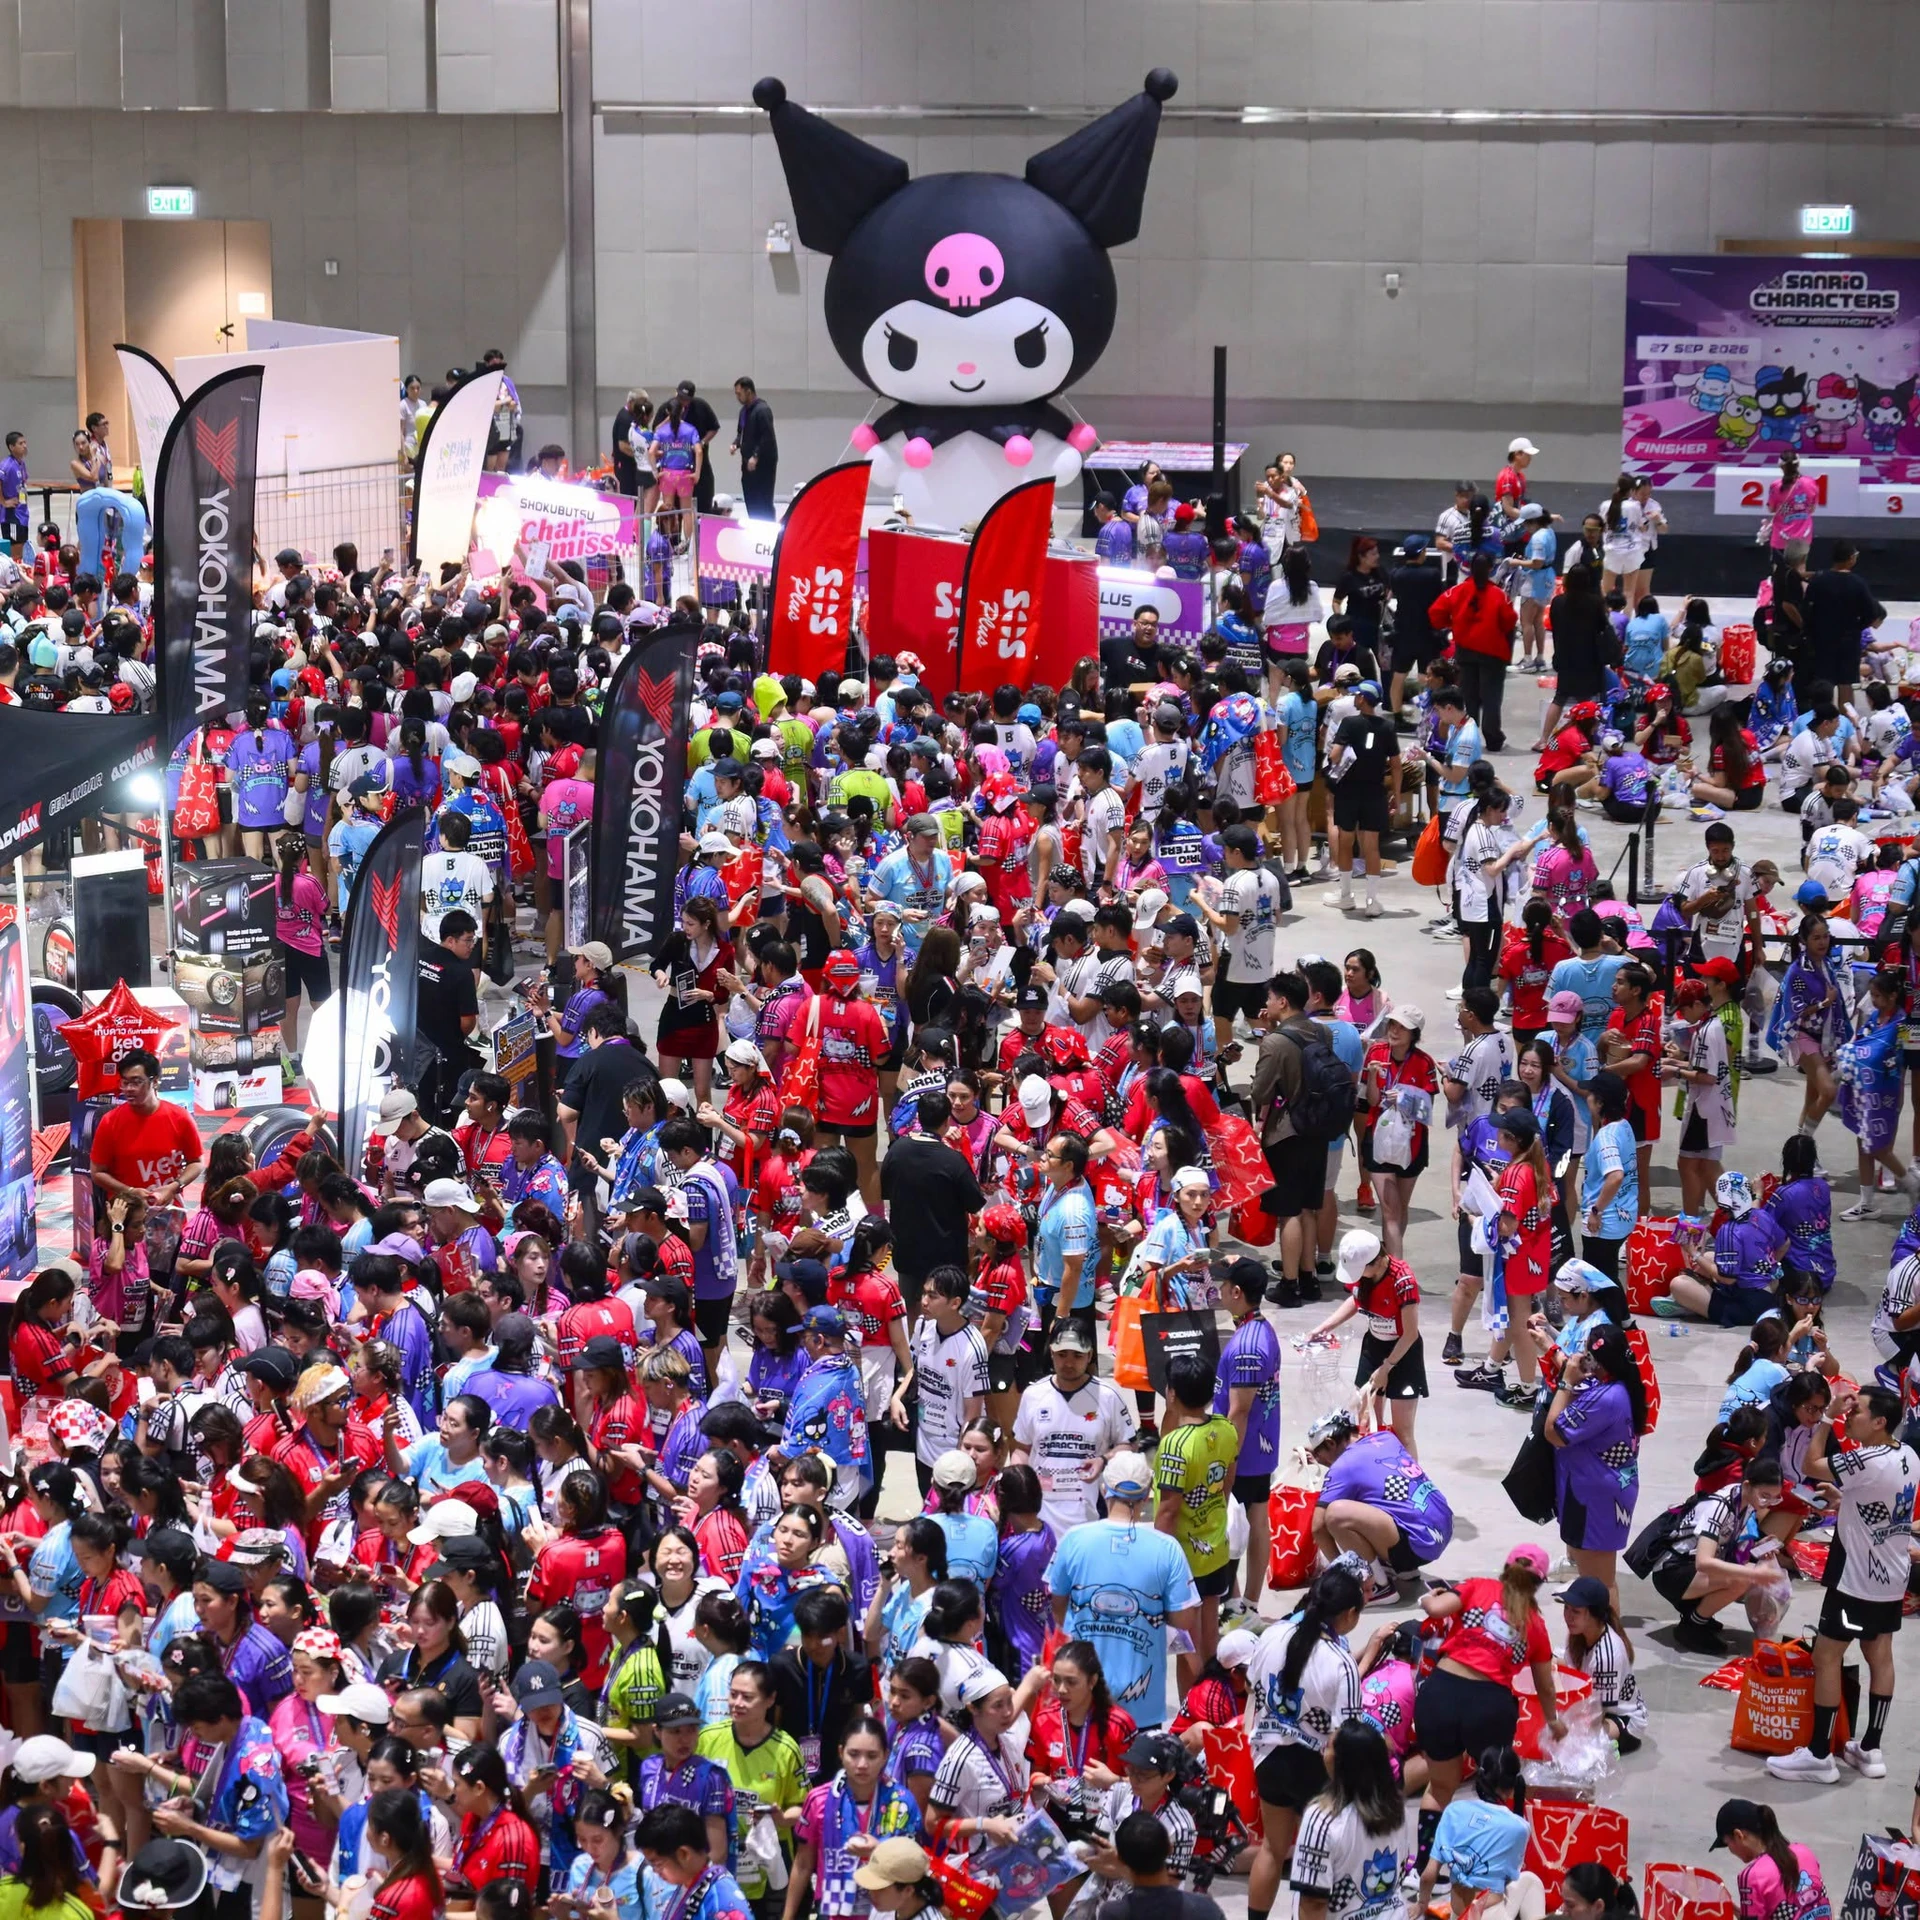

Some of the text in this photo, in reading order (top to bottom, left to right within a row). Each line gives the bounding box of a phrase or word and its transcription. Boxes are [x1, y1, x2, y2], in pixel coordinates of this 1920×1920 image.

[151, 195, 182, 211] EXIT
[1820, 215, 1850, 230] EXIT
[1786, 274, 1863, 289] SANRIO
[1754, 291, 1895, 309] CHARACTERS
[1650, 343, 1750, 355] 27 SEP 2026
[1635, 442, 1707, 455] FINISHER
[1741, 481, 1763, 506] 2
[520, 498, 595, 522] SHOKUBUTSU
[1886, 496, 1903, 513] 3
[194, 487, 230, 714] YOKOHAMA
[788, 575, 810, 622] Plus
[1100, 592, 1132, 607] LUS
[977, 600, 1000, 648] Plus
[1005, 731, 1014, 743] B
[361, 754, 370, 765] B
[1170, 750, 1177, 760] B
[111, 745, 156, 782] ADVAN
[49, 772, 103, 816] GEOLANDAR
[621, 738, 666, 949] YOKOHAMA
[446, 858, 455, 870] B
[833, 1001, 846, 1015] H
[112, 1036, 144, 1049] keb
[1070, 1078, 1084, 1092] H
[137, 1149, 182, 1182] keb
[845, 1281, 856, 1293] H
[599, 1309, 613, 1325] H
[1168, 1330, 1203, 1339] YOKOHAMA
[1050, 1433, 1082, 1442] SANRIO
[1039, 1442, 1096, 1451] CHARACTERS
[585, 1550, 599, 1567] H
[1079, 1622, 1143, 1643] CINNAMOROLL
[530, 1676, 544, 1690] NY
[1750, 1690, 1796, 1705] PROTEIN
[1759, 1704, 1774, 1712] THIS
[1747, 1711, 1799, 1729] WHOLE
[1752, 1723, 1792, 1741] FOOD
